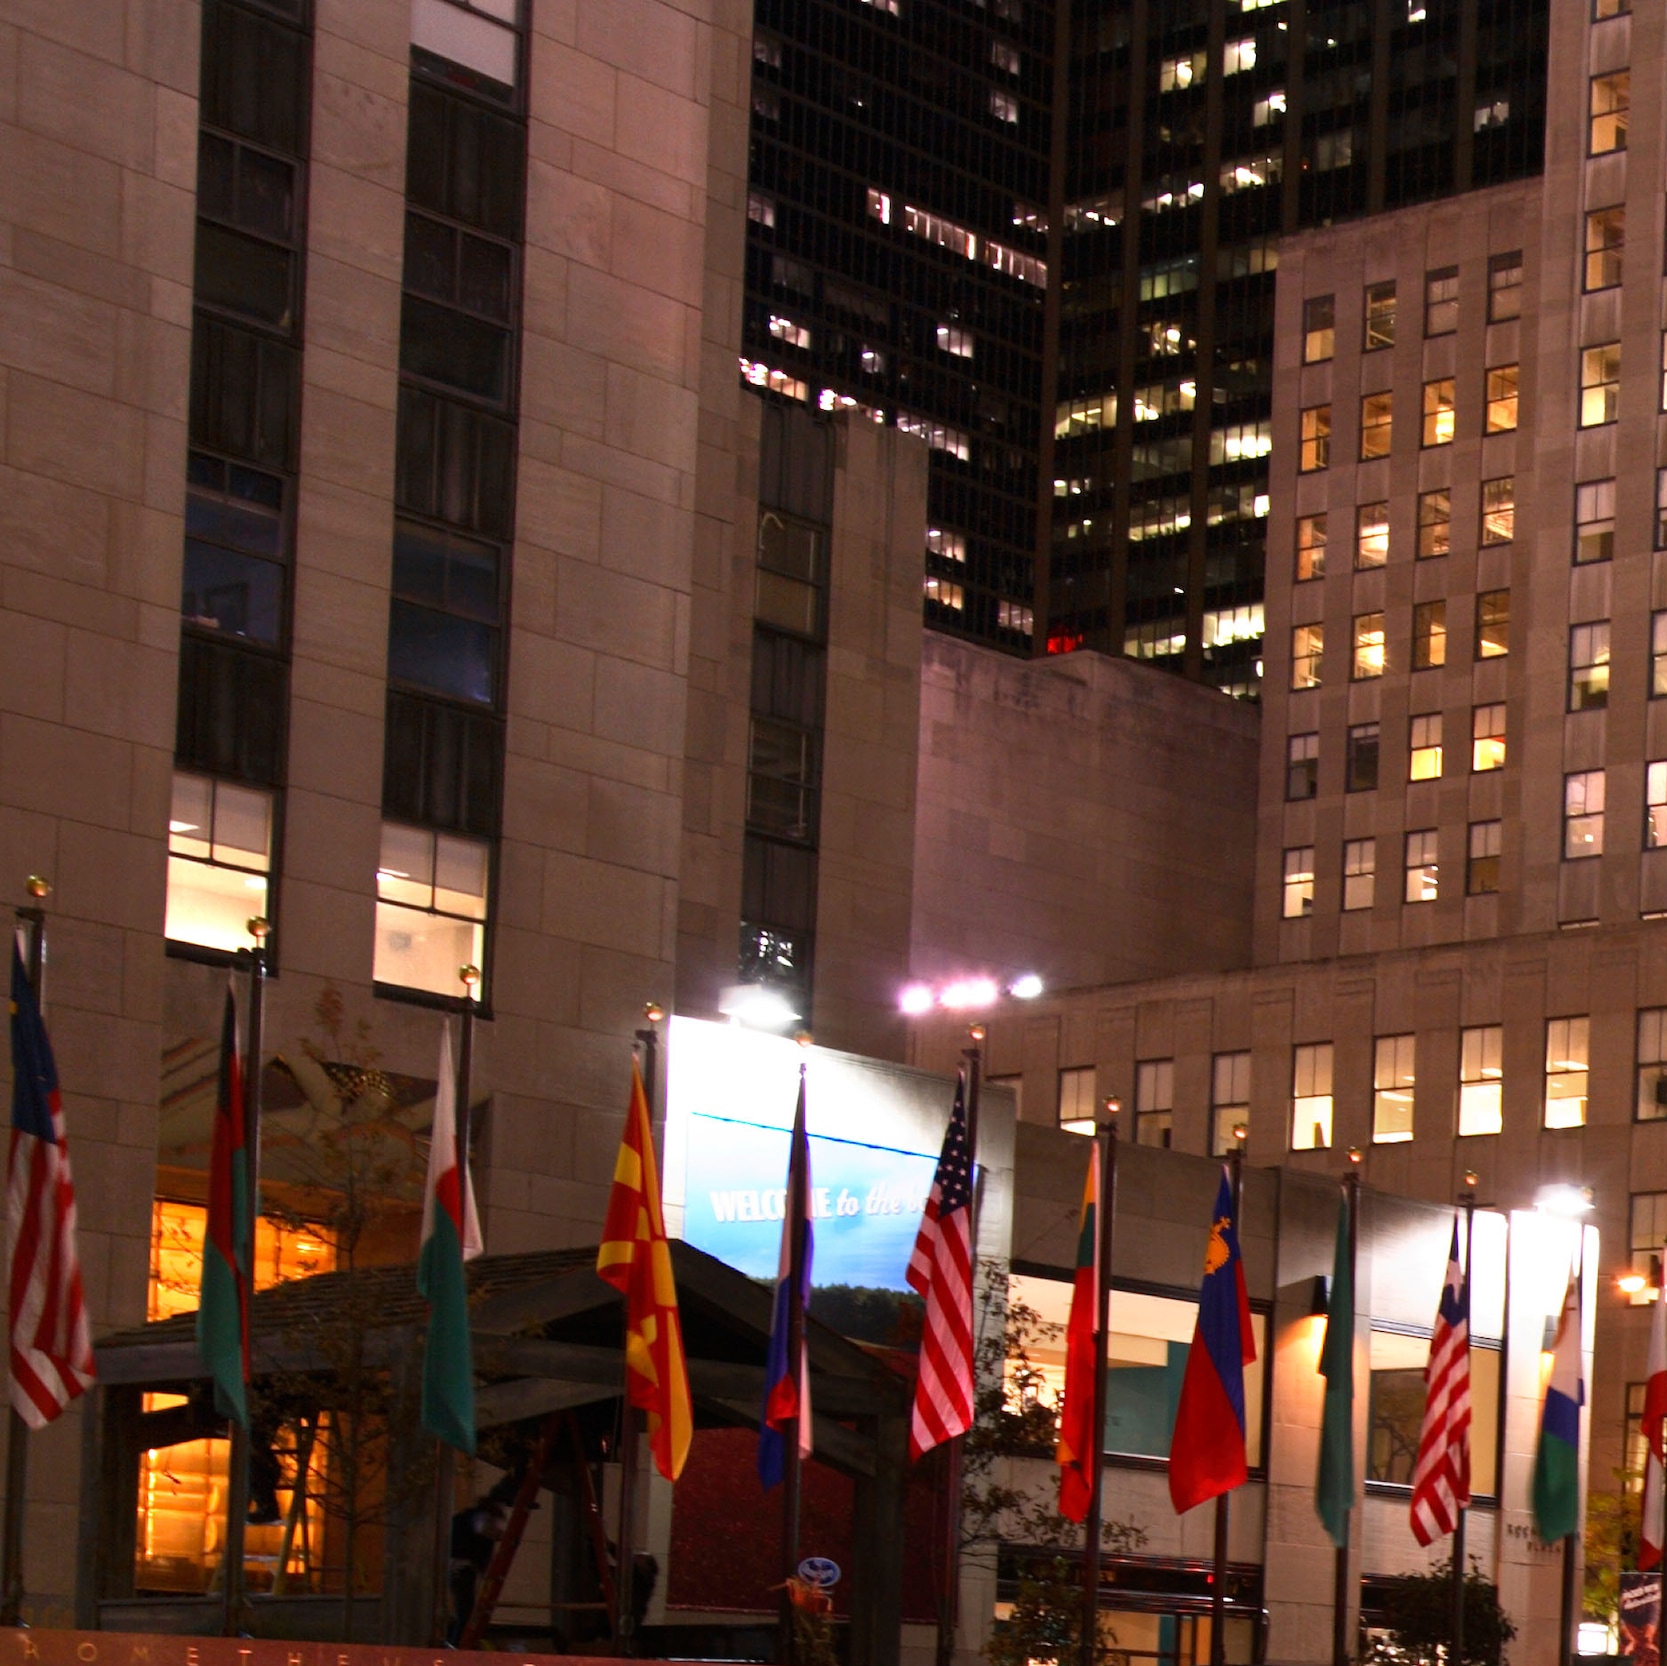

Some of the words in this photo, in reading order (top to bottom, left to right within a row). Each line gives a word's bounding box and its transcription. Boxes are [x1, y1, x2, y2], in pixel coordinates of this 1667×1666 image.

[709, 1187, 832, 1223] WELCOE
[837, 1189, 860, 1217] to
[864, 1183, 902, 1216] the
